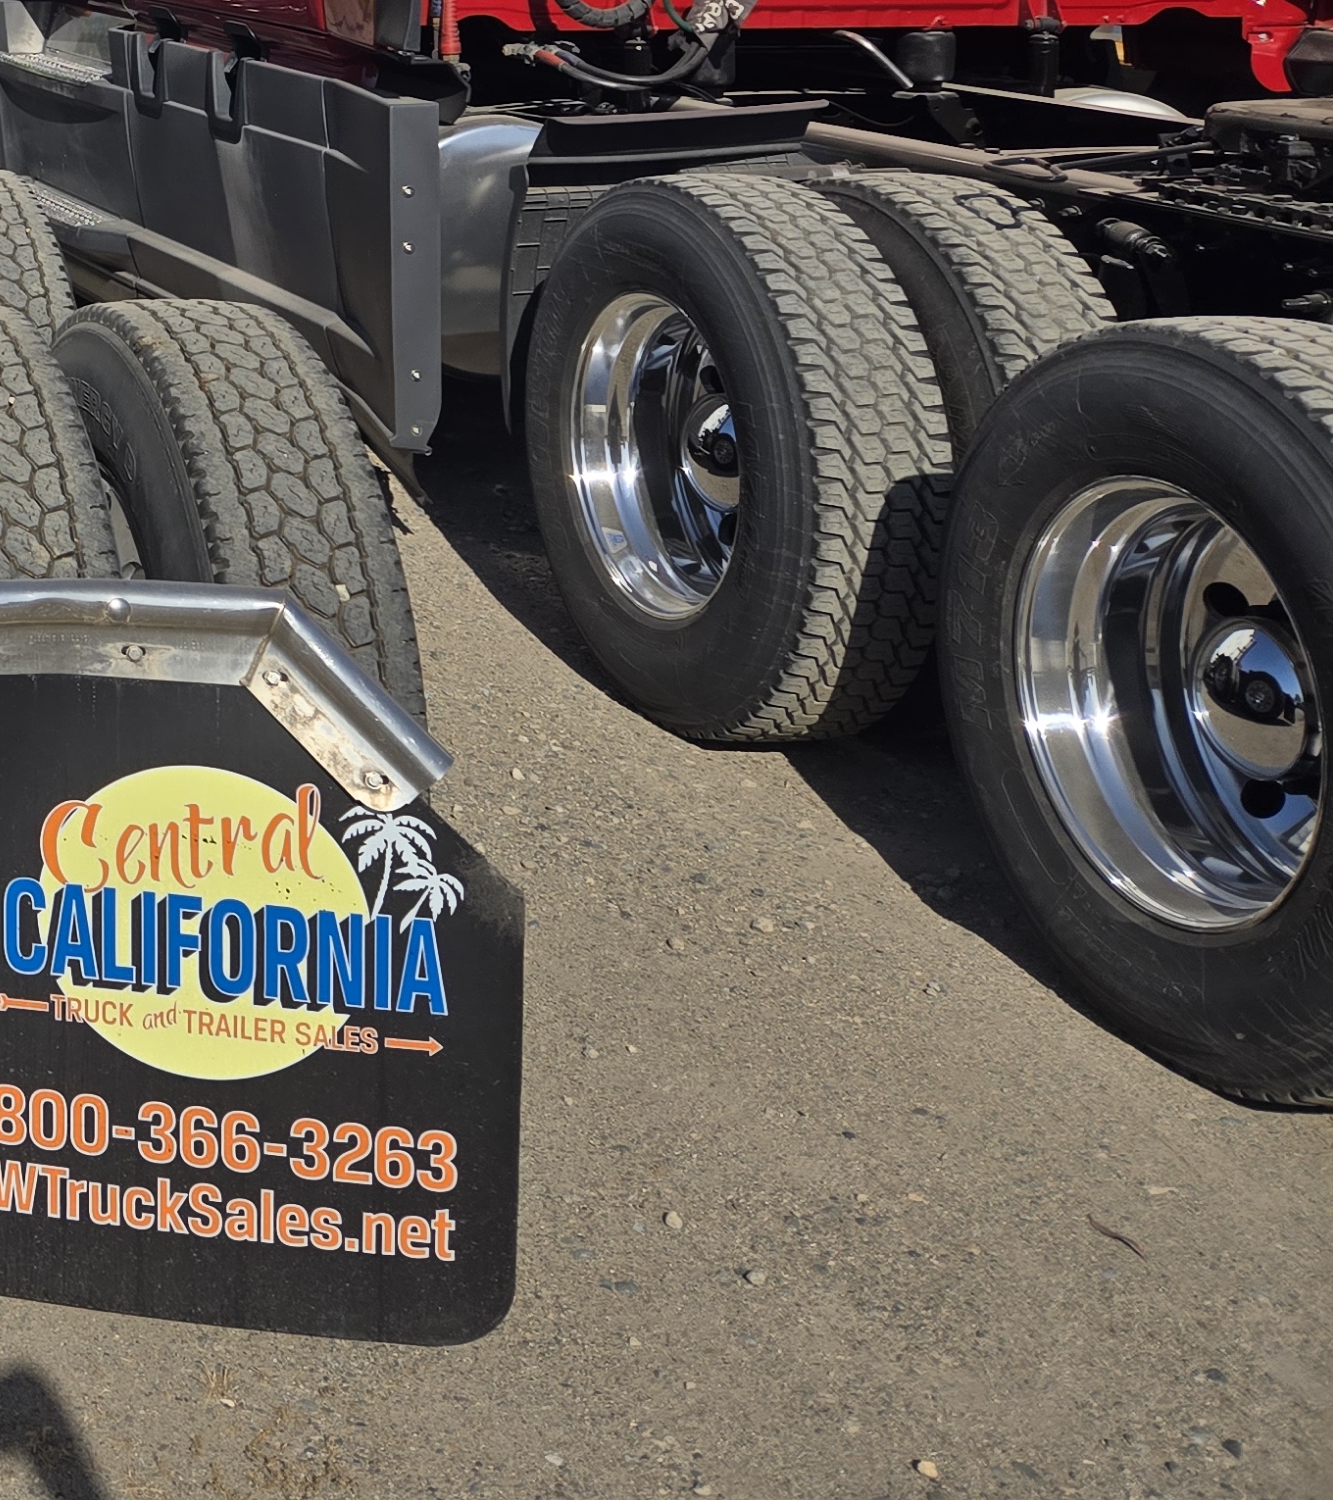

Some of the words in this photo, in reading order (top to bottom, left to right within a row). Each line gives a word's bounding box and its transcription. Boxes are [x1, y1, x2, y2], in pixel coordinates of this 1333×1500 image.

[40, 783, 325, 893] Central
[3, 876, 449, 1017] CALIFORNIA
[49, 993, 134, 1028] TRUCK
[143, 1001, 178, 1031] and
[183, 1010, 286, 1044] TRAILER
[295, 1021, 379, 1054] SALES
